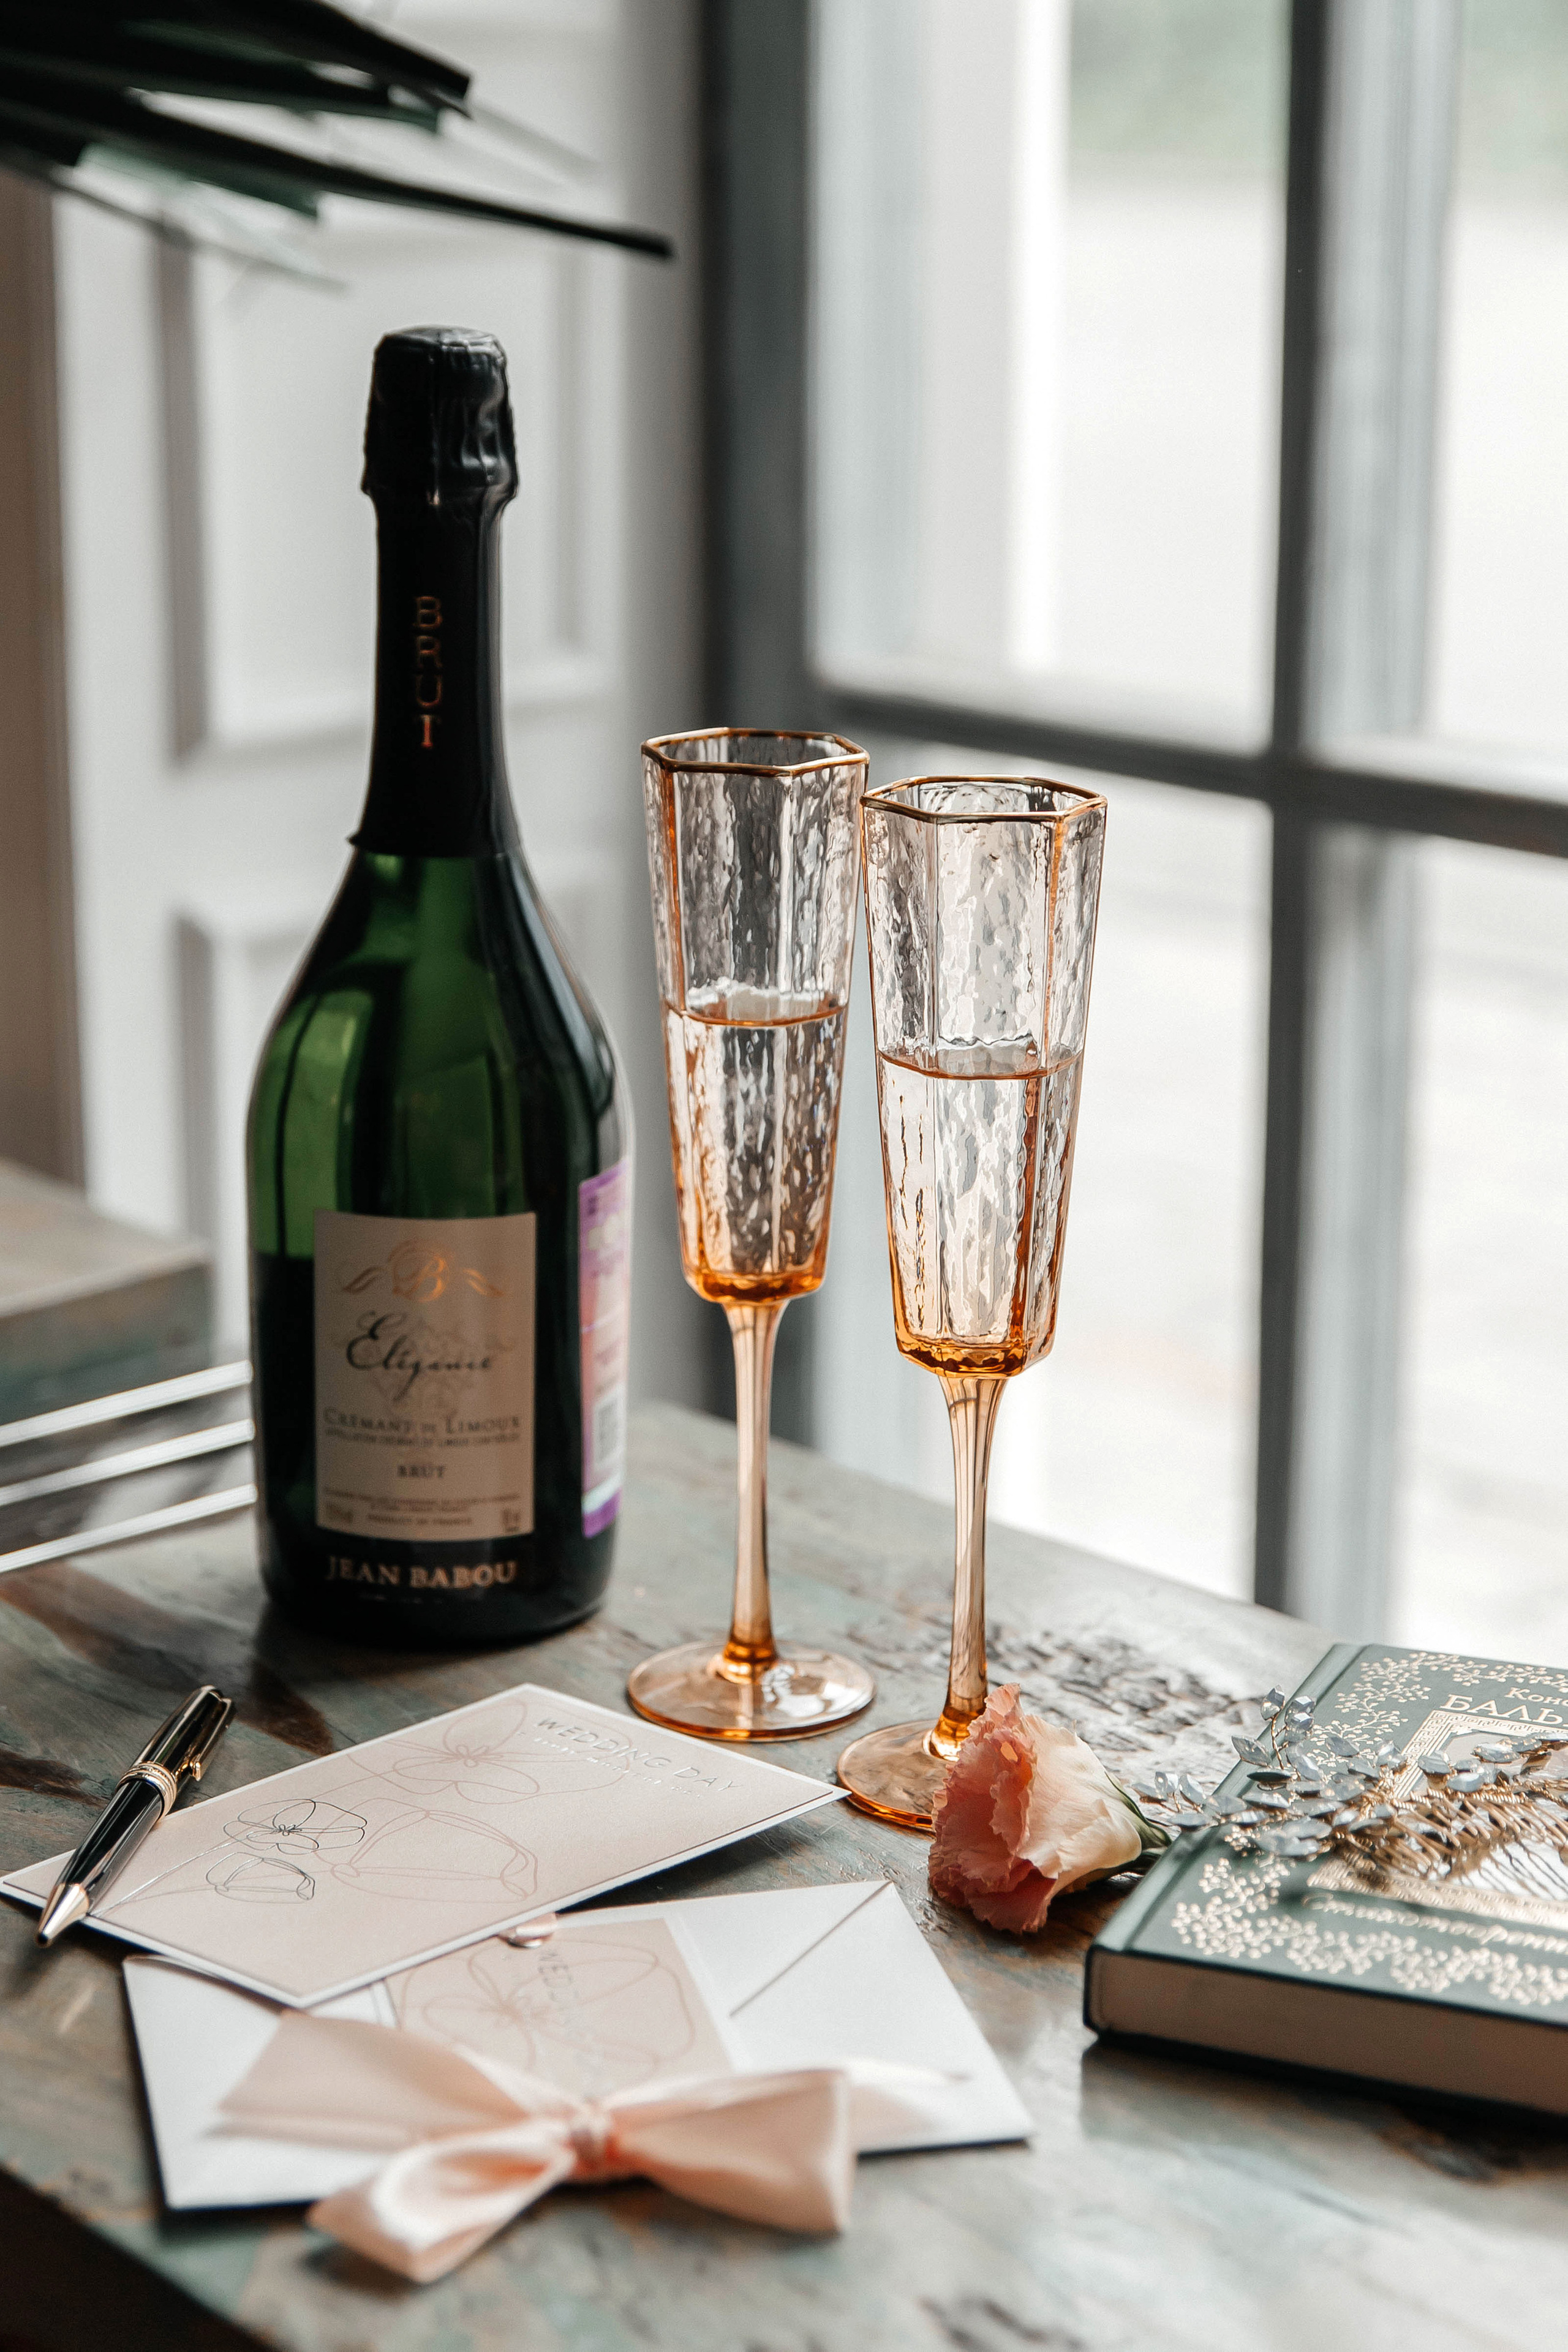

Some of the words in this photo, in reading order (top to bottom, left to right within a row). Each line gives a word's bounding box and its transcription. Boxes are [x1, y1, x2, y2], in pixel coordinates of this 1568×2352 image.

[413, 595, 443, 748] BRUT
[325, 1555, 399, 1585] JEAN
[409, 1561, 518, 1589] BABOU
[1439, 1694, 1568, 1727] БАЛЬ
[536, 1717, 672, 1769] WEDDING
[673, 1766, 744, 1792] DAY
